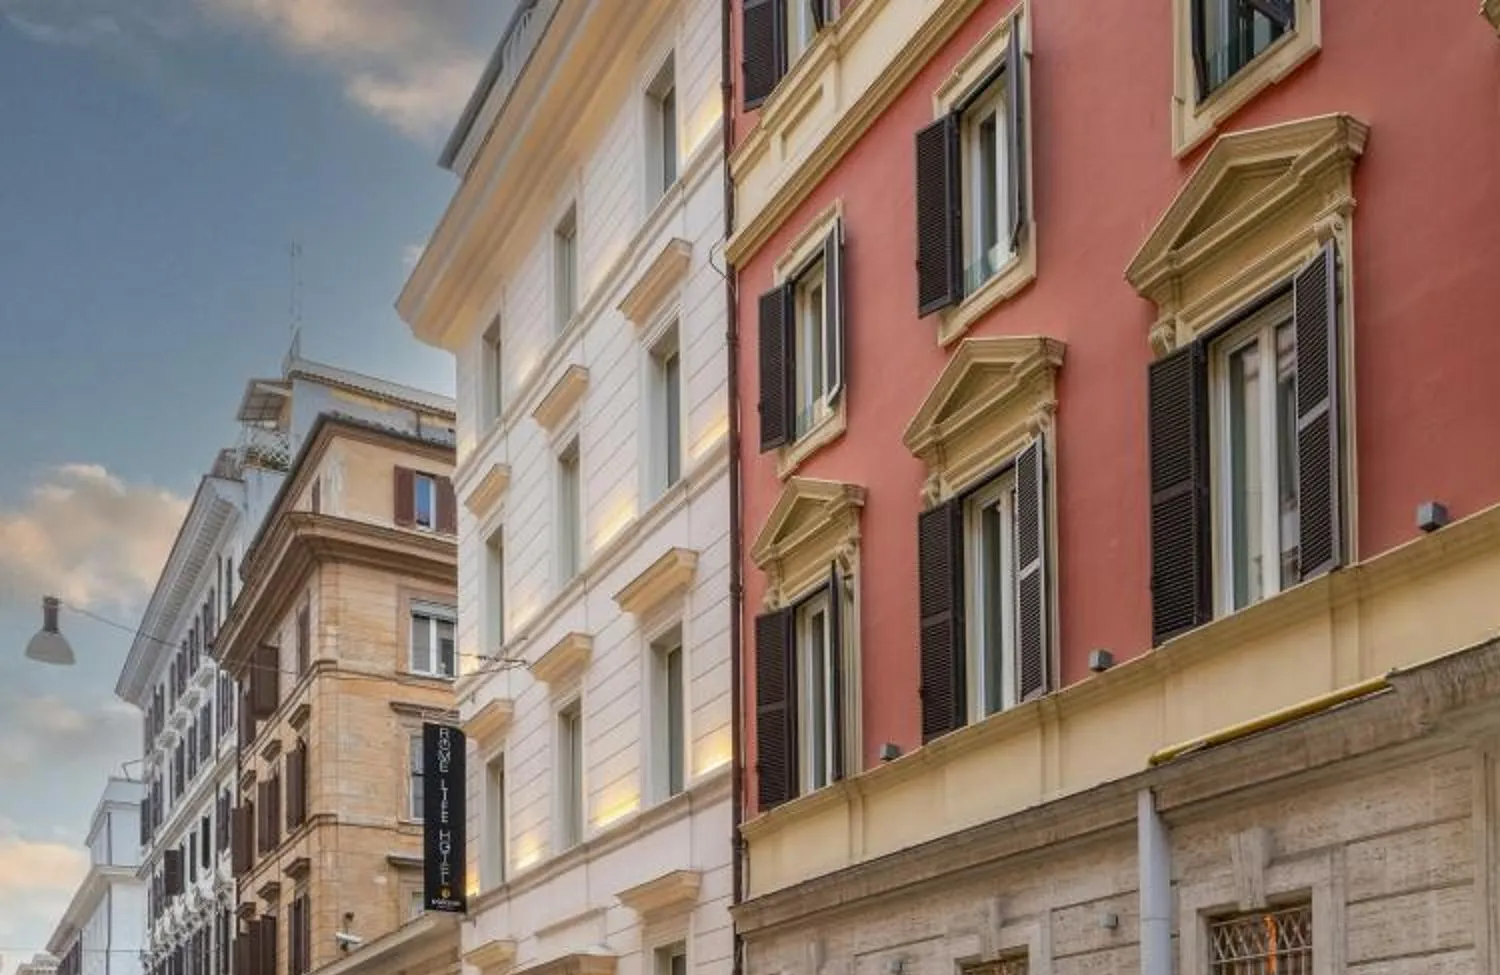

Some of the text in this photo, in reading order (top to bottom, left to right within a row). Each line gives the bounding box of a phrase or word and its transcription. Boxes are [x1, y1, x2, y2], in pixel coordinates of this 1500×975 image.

[438, 727, 450, 885] ROME LIFE HOTEL
